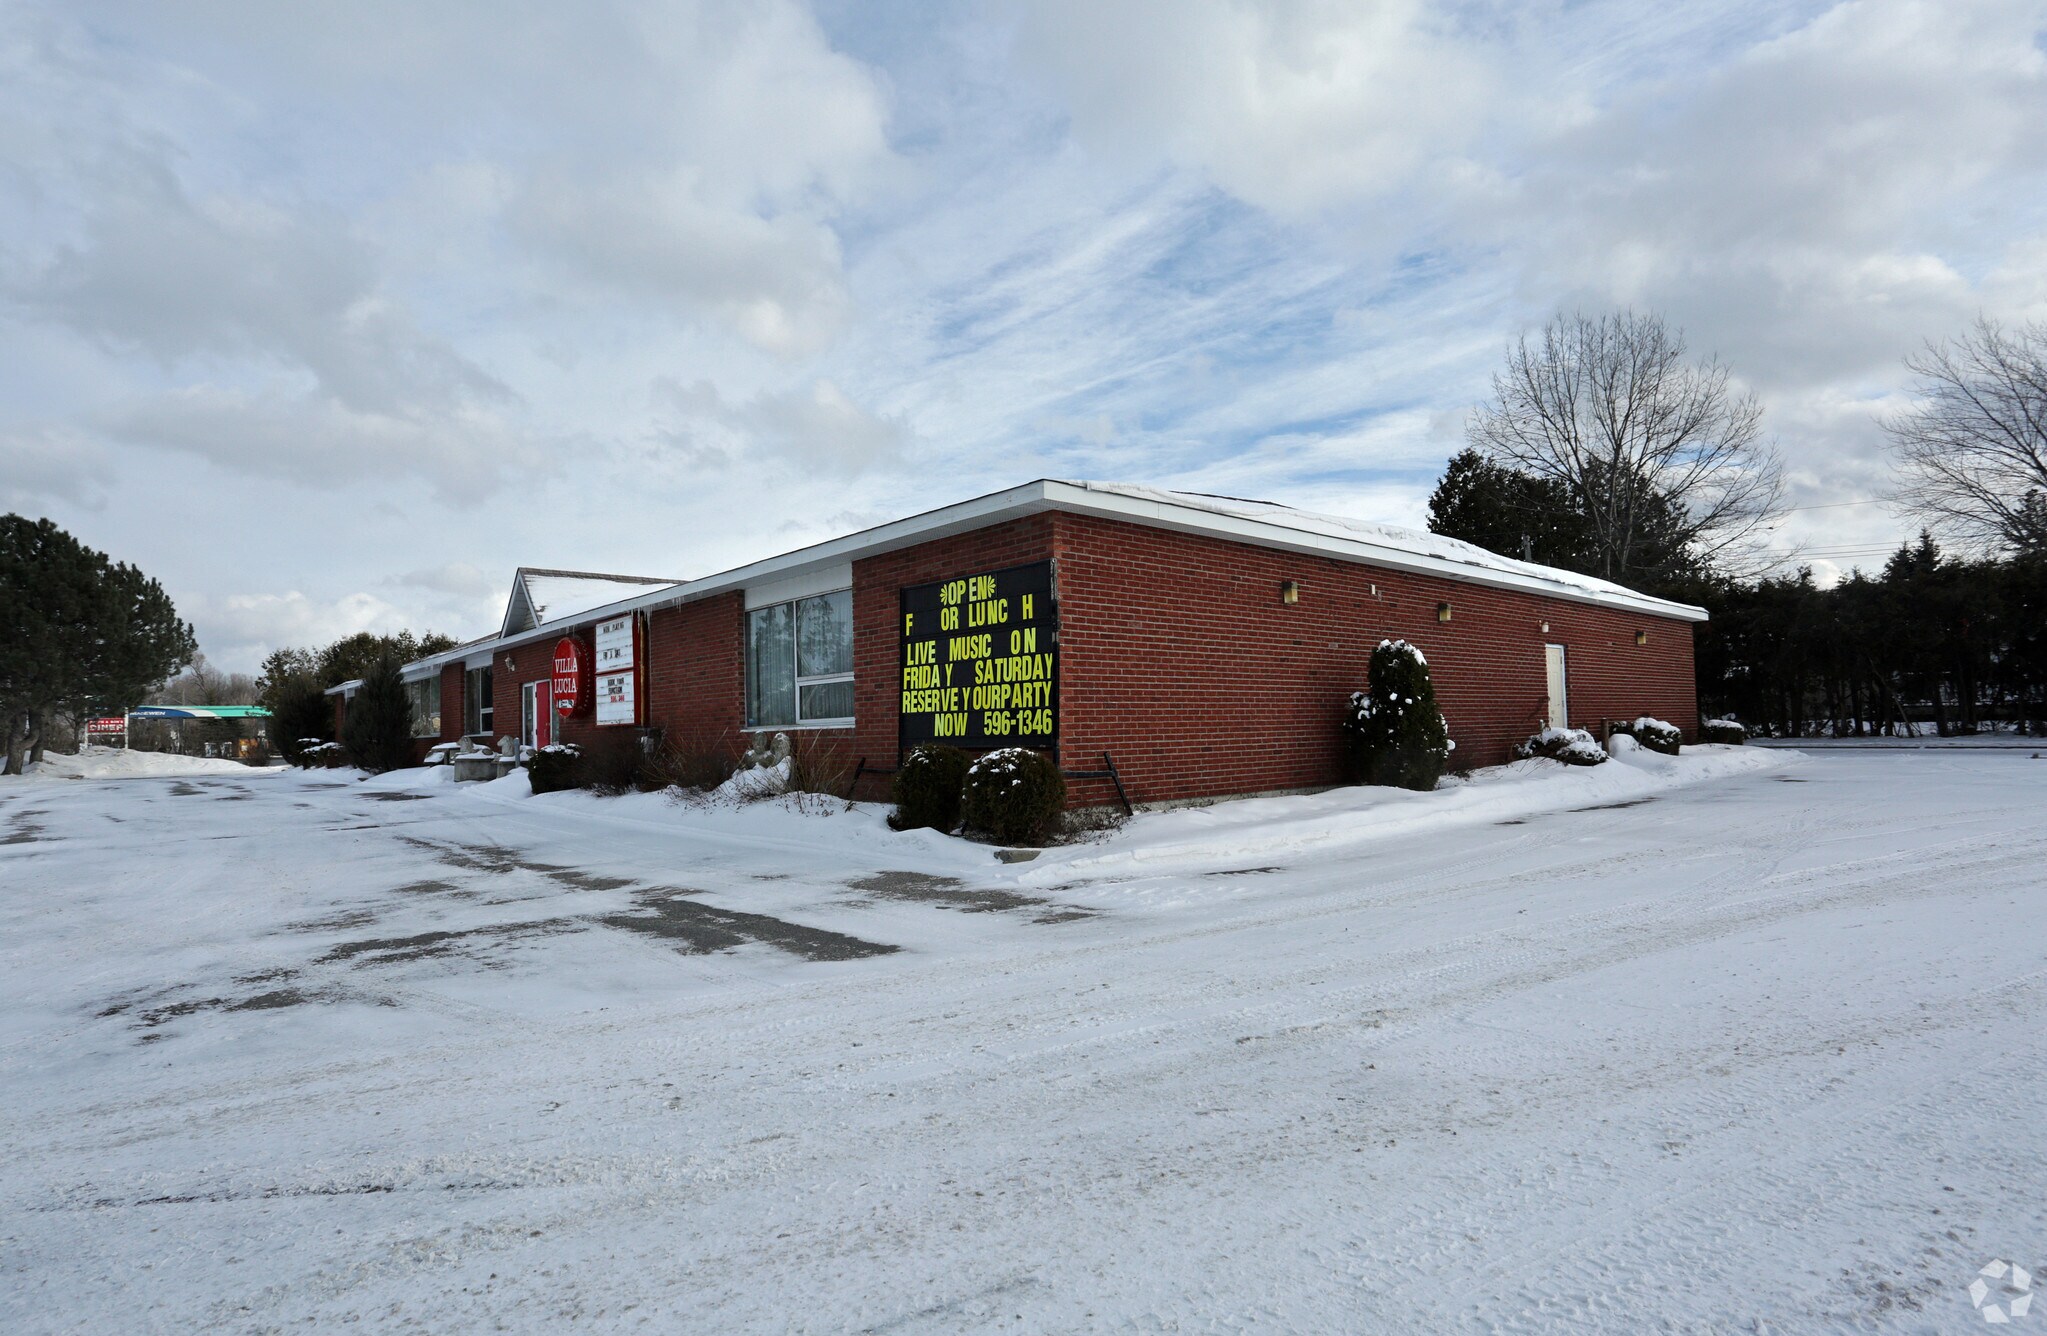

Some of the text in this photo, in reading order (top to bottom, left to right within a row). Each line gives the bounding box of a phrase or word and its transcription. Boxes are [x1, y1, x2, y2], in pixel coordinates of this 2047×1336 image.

[948, 576, 987, 605] OPEN
[906, 628, 1037, 666] LIVE MUSIC ON
[554, 657, 578, 673] VILLA
[903, 653, 1053, 690] FRIDAY SATURDAY
[554, 677, 577, 694] LUCIA
[902, 687, 958, 714] RESERVE
[934, 709, 1053, 737] NOW 596-1346
